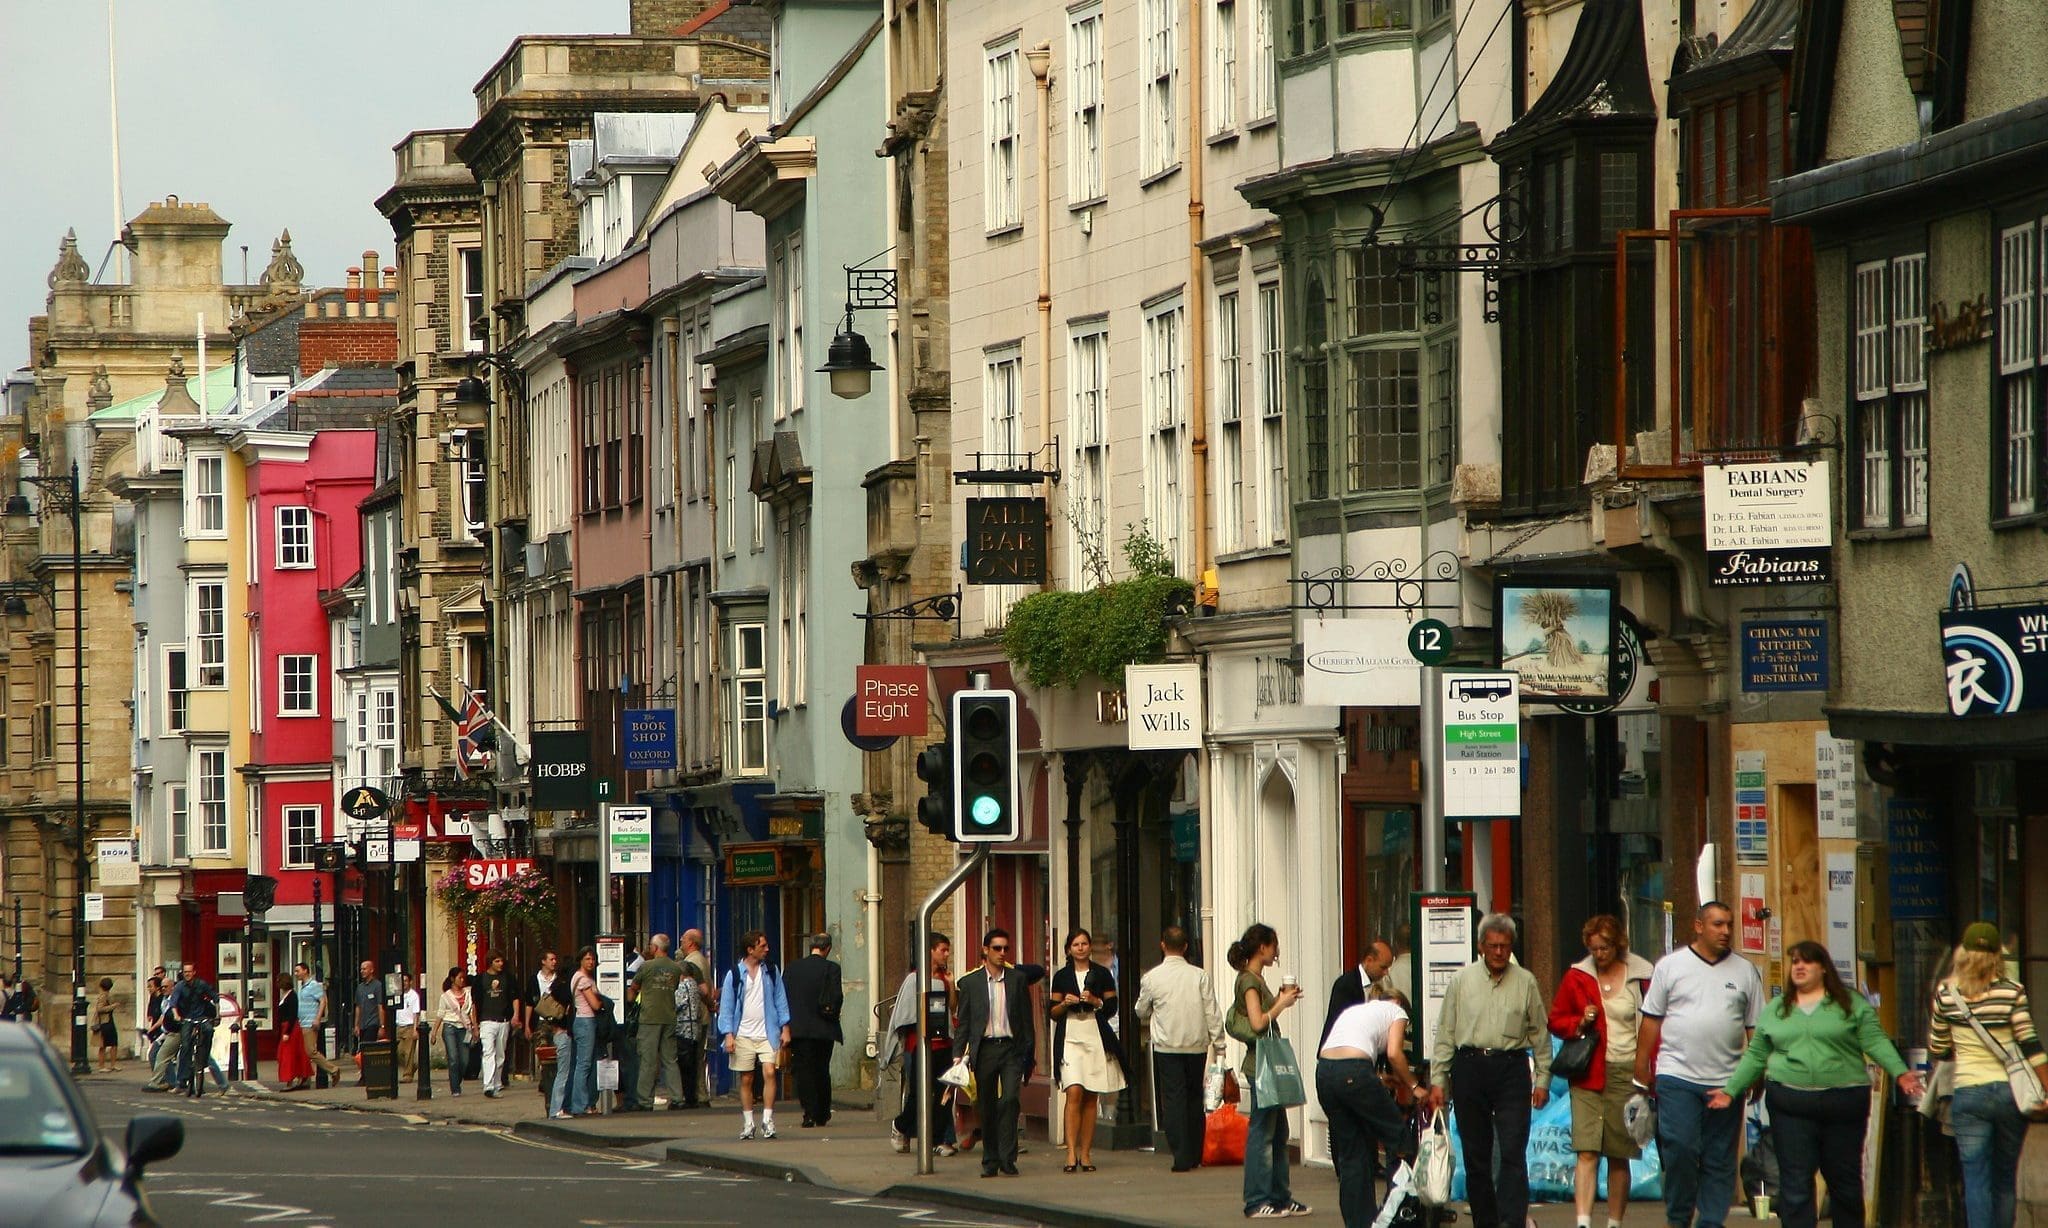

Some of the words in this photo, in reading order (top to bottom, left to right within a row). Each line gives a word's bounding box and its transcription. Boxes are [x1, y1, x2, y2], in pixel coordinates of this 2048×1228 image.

[1728, 468, 1808, 485] FABIANS
[1730, 488, 1763, 498] Dental
[1766, 487, 1806, 498] Surgery
[980, 505, 1034, 524] ALL
[1713, 513, 1726, 521] Dr.
[1748, 511, 1776, 520] Fabian
[1713, 526, 1727, 534] Dr.
[1729, 525, 1747, 533] L.R.
[1750, 525, 1778, 533] Fabian
[978, 531, 1035, 551] BAR
[1714, 538, 1727, 547] Dr.
[1752, 536, 1780, 545] Fabian
[976, 556, 1038, 577] ONE
[1720, 551, 1820, 575] Fabians
[1714, 577, 1759, 585] HEALTH
[1779, 574, 1827, 583] BEAUTY
[1749, 627, 1794, 639] CHIANG
[1797, 626, 1820, 638] MAI
[1419, 628, 1441, 650] i2
[1759, 640, 1813, 651] KITCHEN
[1772, 664, 1799, 673] THAI
[1752, 673, 1819, 684] RESTAURANT
[865, 679, 919, 696] Phase
[1143, 682, 1184, 707] Jack
[865, 700, 910, 721] Eight
[1458, 710, 1477, 720] Bus
[1480, 709, 1504, 722] Stop
[632, 722, 666, 731] BOOK
[1141, 712, 1190, 731] Wills
[632, 733, 666, 742] SHOP
[1460, 730, 1477, 739] High
[1479, 729, 1501, 738] Street
[629, 750, 671, 759] OXFORD
[1461, 750, 1475, 758] Rail
[1477, 750, 1502, 758] Station
[1452, 767, 1457, 775] 5
[1469, 767, 1478, 775] 13
[1485, 767, 1498, 775] 261
[1503, 767, 1517, 775] 280
[469, 863, 530, 886] SALE
[1427, 897, 1449, 906] oxford
[1536, 1126, 1571, 1137] TRA
[1533, 1141, 1572, 1155] WAS
